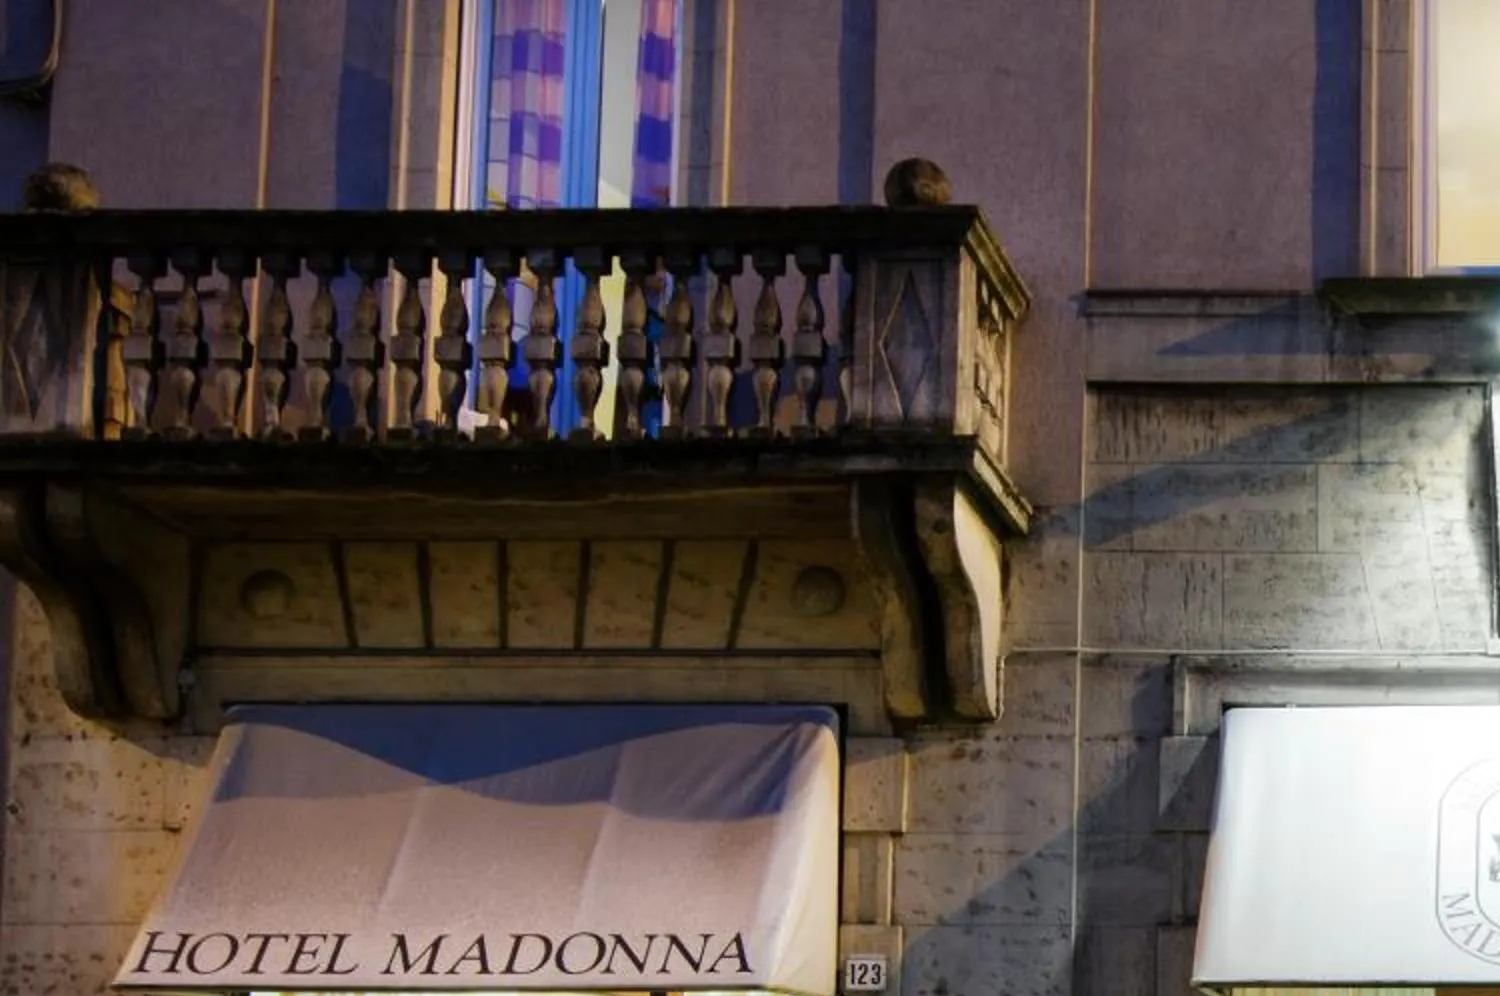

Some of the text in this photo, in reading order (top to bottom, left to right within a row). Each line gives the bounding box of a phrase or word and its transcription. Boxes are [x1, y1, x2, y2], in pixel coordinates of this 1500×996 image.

[132, 930, 754, 975] HOTEL MADONNA
[851, 963, 881, 985] 123
